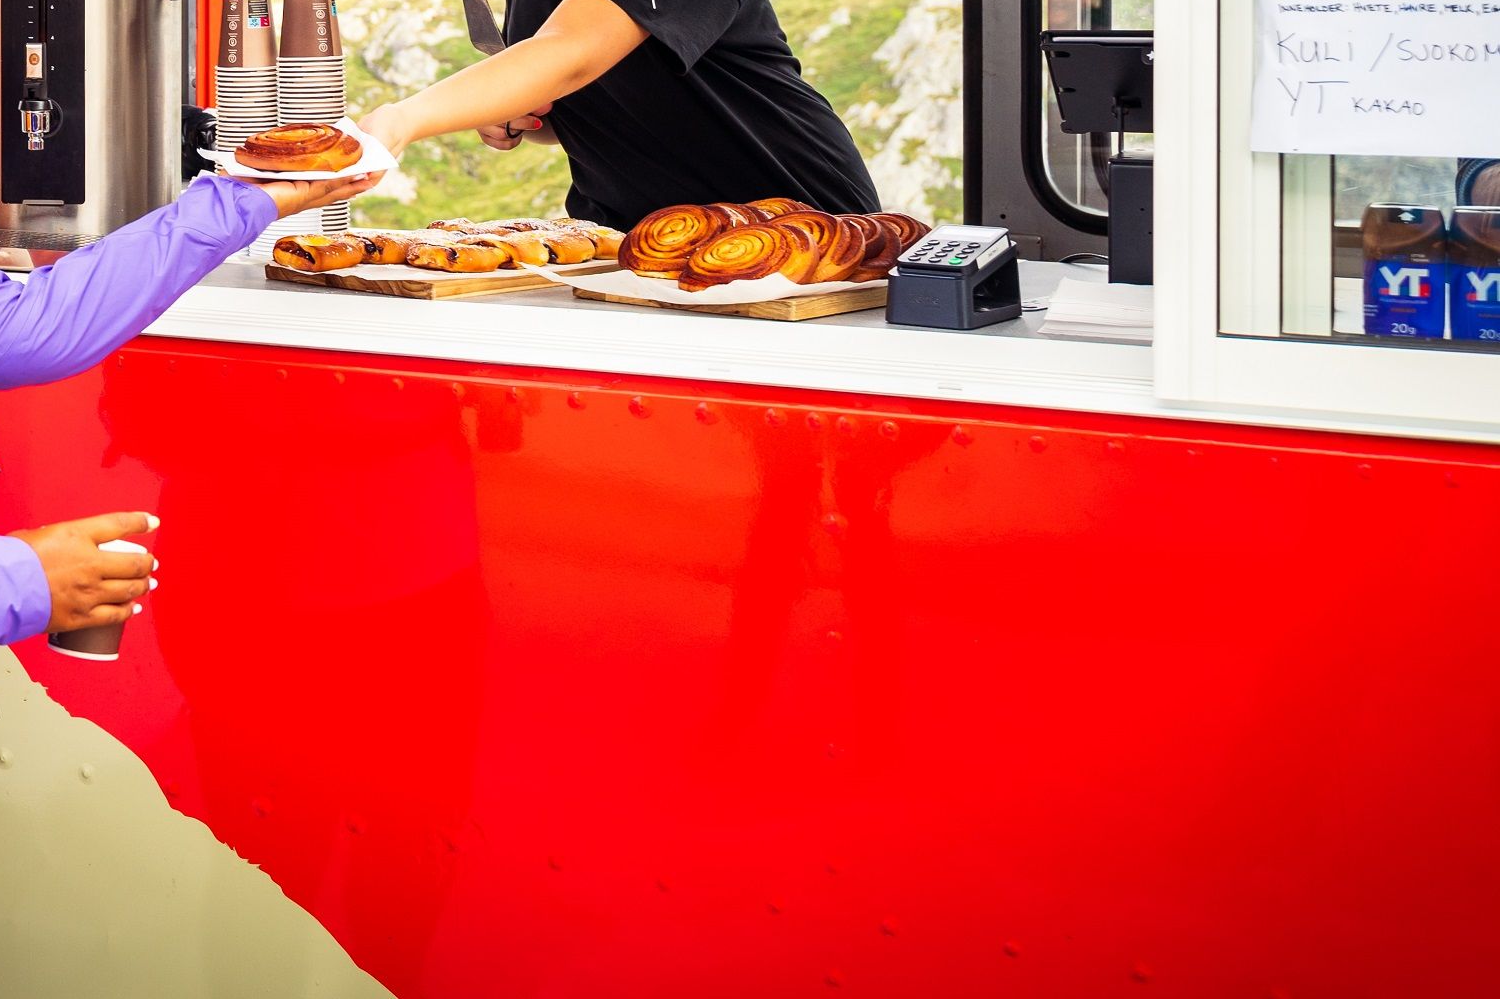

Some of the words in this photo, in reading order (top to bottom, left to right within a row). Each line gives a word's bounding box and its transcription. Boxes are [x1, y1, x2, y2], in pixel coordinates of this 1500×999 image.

[1277, 77, 1350, 117] YT
[1351, 97, 1426, 117] KAKAO
[1379, 266, 1429, 297] YT
[1390, 322, 1417, 335] 20g
